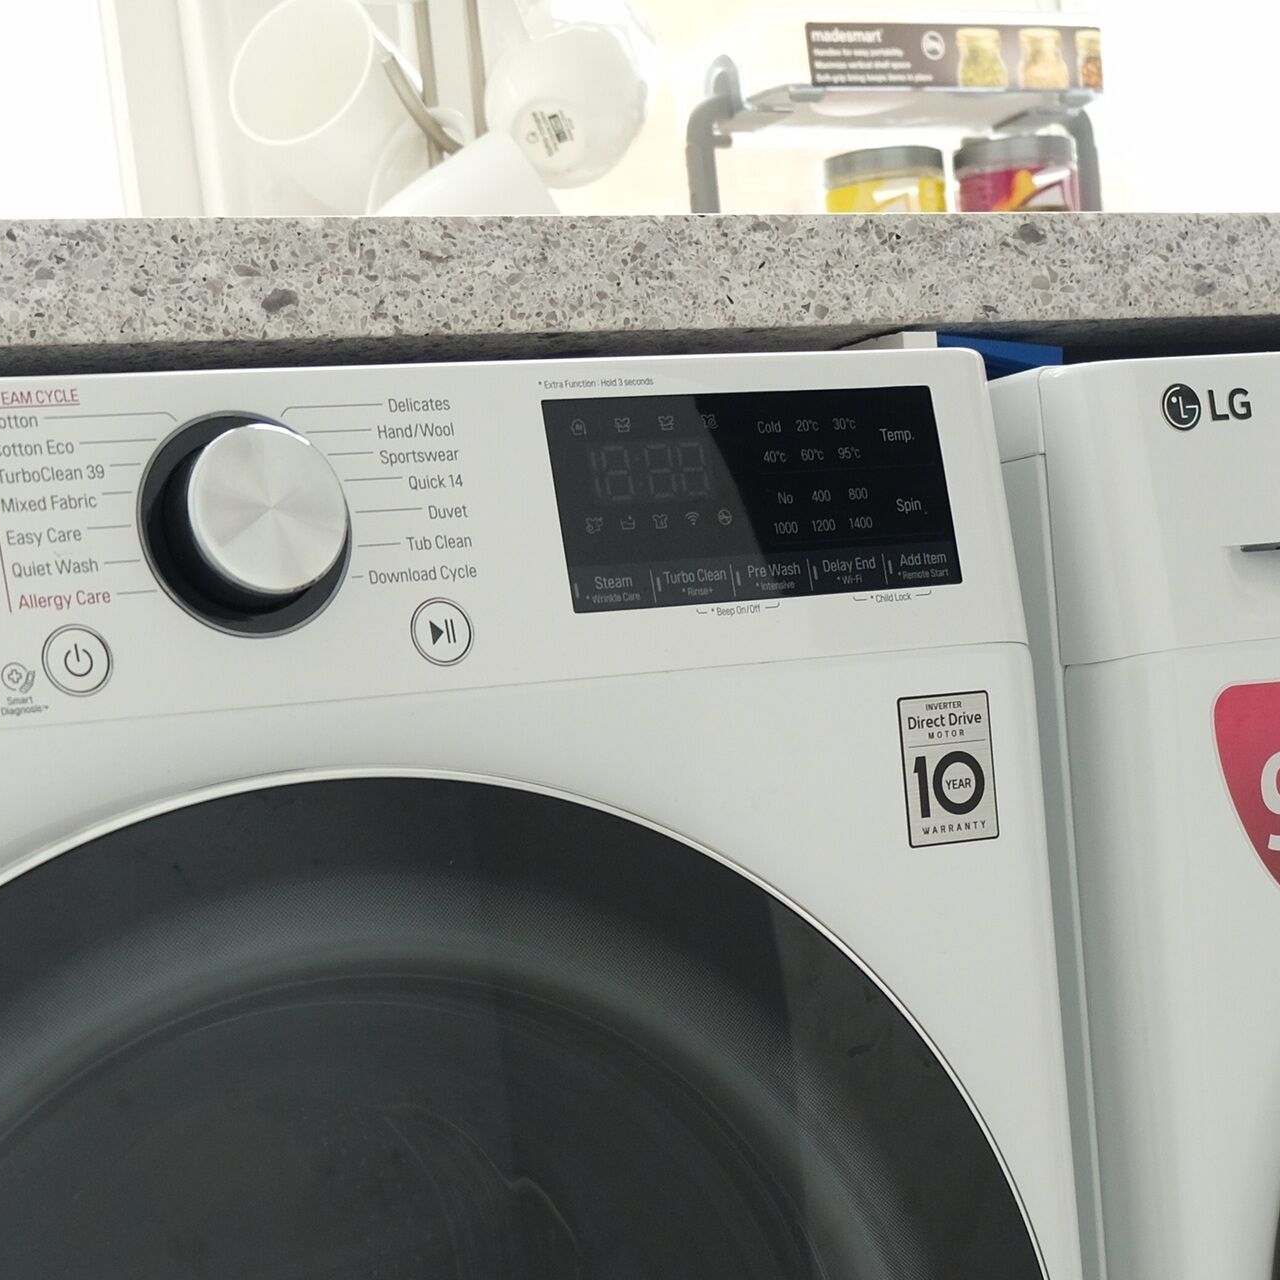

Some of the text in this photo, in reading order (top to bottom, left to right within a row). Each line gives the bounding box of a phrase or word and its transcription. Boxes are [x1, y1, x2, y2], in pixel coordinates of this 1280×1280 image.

[811, 29, 881, 42] madesmart
[544, 380, 564, 389] Extra
[564, 379, 596, 388] Function
[600, 378, 617, 387] Hold
[624, 377, 654, 386] seconds
[35, 388, 80, 404] CYCLE
[1208, 387, 1252, 421] LG
[388, 398, 451, 413] Delicates
[377, 422, 455, 440] Hand/Wool
[757, 420, 782, 434] Cold
[879, 428, 915, 444] Temp.
[46, 439, 74, 455] Eco
[379, 449, 459, 467] Sportswear
[86, 464, 105, 480] 39
[408, 473, 463, 491] Quick 14
[1, 494, 97, 513] Mixed Fabric
[777, 487, 869, 505] No 400 800
[428, 505, 468, 520] Duvet
[896, 498, 922, 515] Spin
[773, 516, 873, 535] 1000 1200 1400
[5, 527, 82, 547] Easy Care
[406, 535, 472, 551] Tub Clean
[822, 556, 877, 574] Delay End
[899, 551, 948, 567] Add Item
[11, 558, 99, 578] Quiet Wash
[368, 564, 477, 585] Download Cycle
[748, 562, 801, 578] Pre Wash
[902, 568, 950, 580] Remote Start
[594, 576, 633, 590] Steam
[663, 568, 727, 585] Turbo Clean
[842, 575, 863, 585] Wi-Fi
[760, 580, 795, 590] Intensive
[18, 590, 111, 610] Allergy Care
[591, 592, 641, 604] Wrinkle Care
[875, 592, 912, 603] Child Lock
[716, 604, 761, 617] Beep On/Off
[6, 695, 33, 706] Smart
[925, 701, 962, 711] INVERTER
[907, 712, 982, 730] Direct Drive
[928, 729, 965, 740] MOTOR
[914, 751, 985, 818] 10
[945, 778, 972, 790] YEAR
[922, 821, 986, 835] WARRANTY
